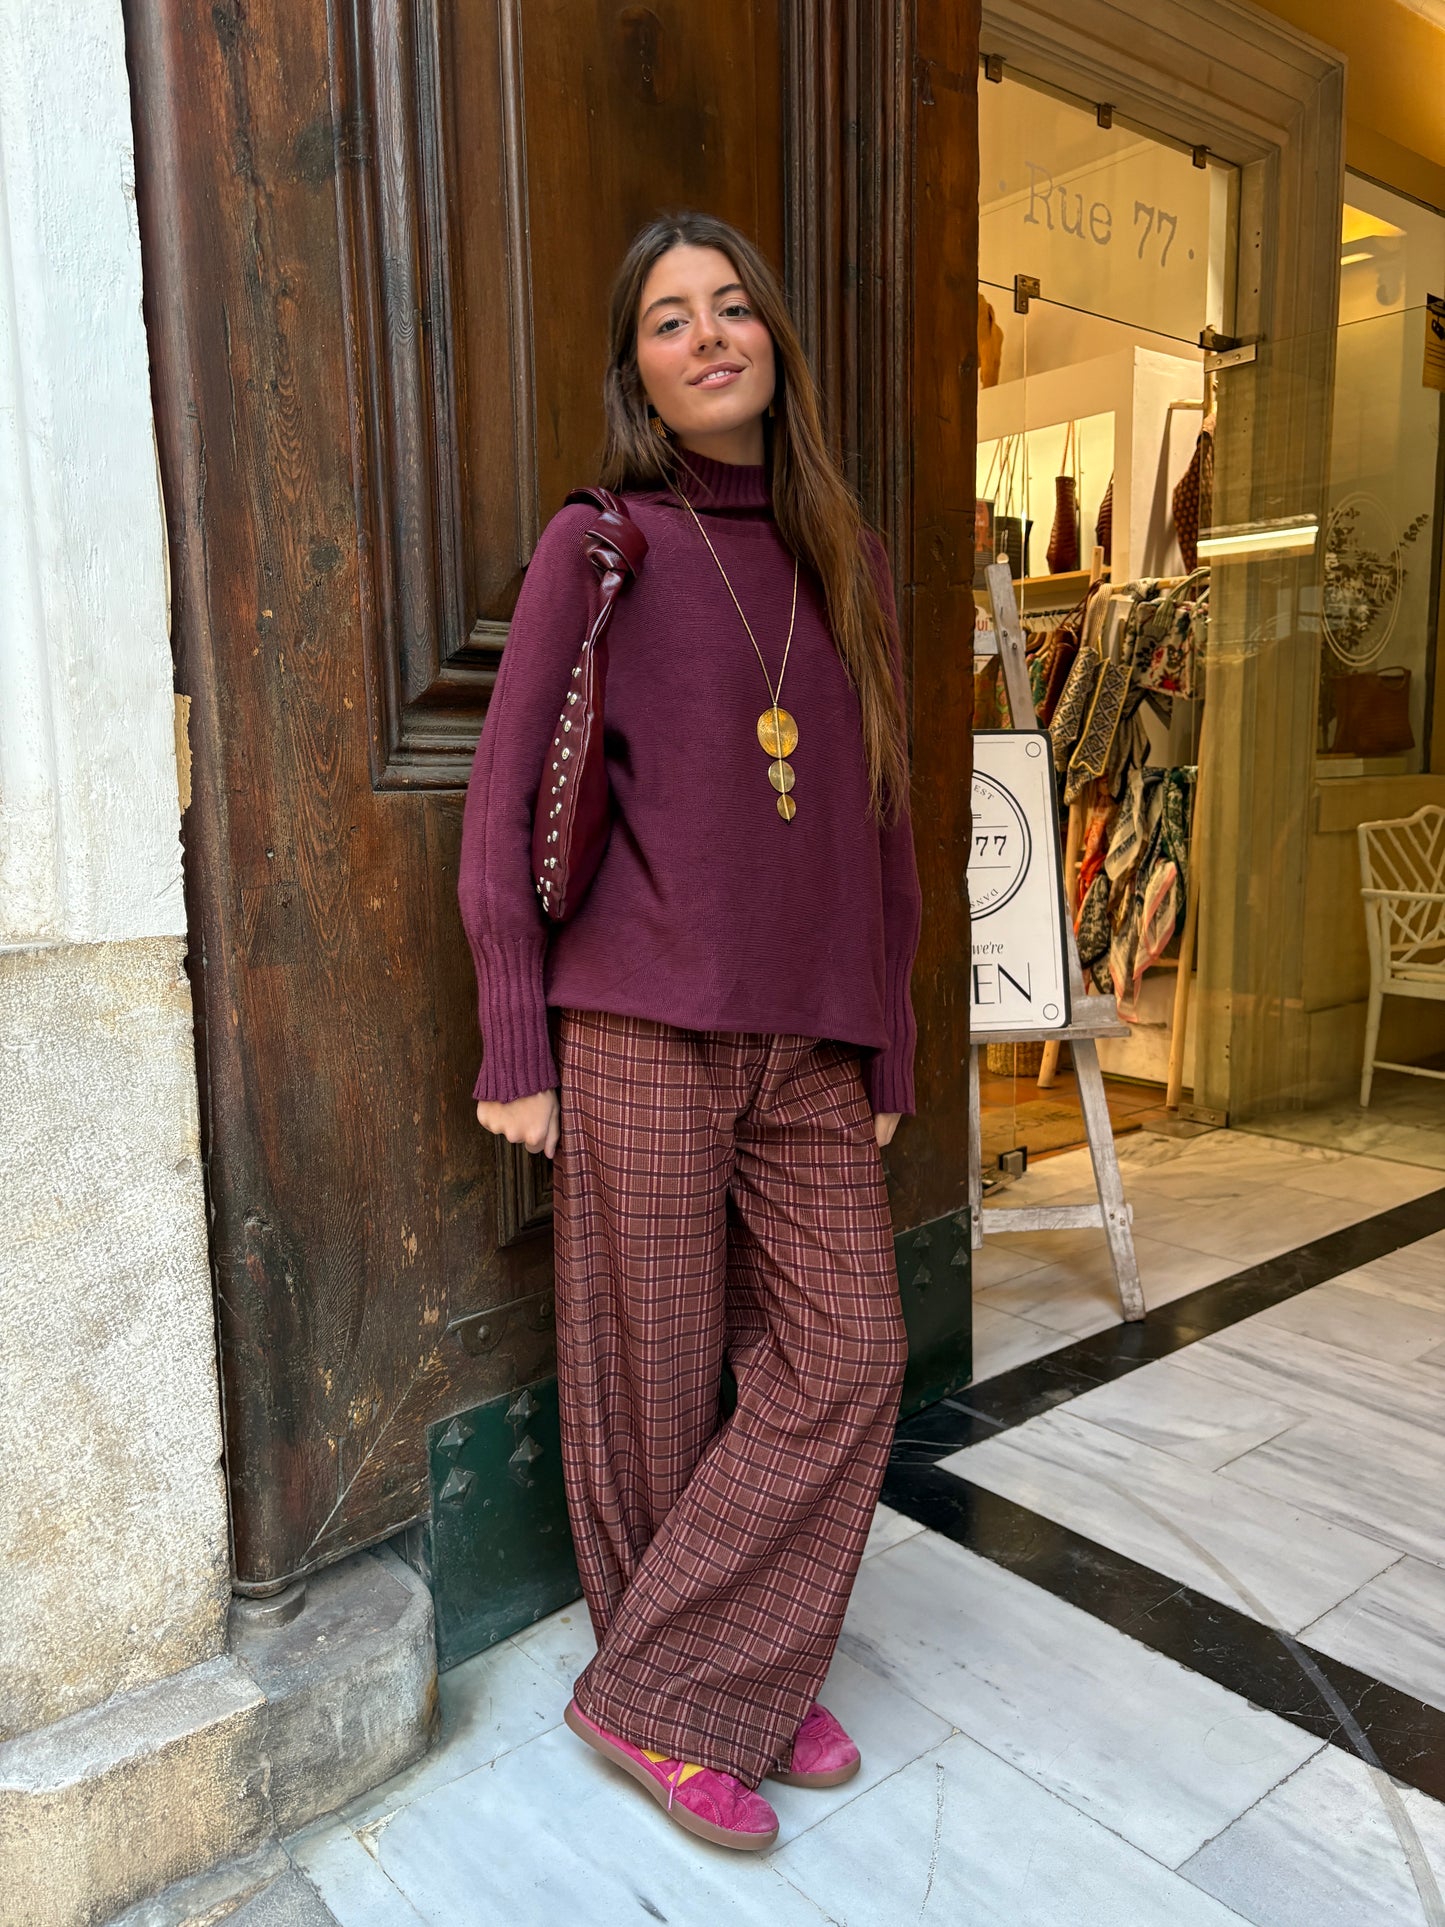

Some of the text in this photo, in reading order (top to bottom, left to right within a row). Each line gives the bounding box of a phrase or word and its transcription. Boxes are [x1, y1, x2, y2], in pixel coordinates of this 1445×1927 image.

[976, 835, 1007, 857] 77
[972, 941, 1004, 955] we're
[973, 962, 1031, 1005] EN
